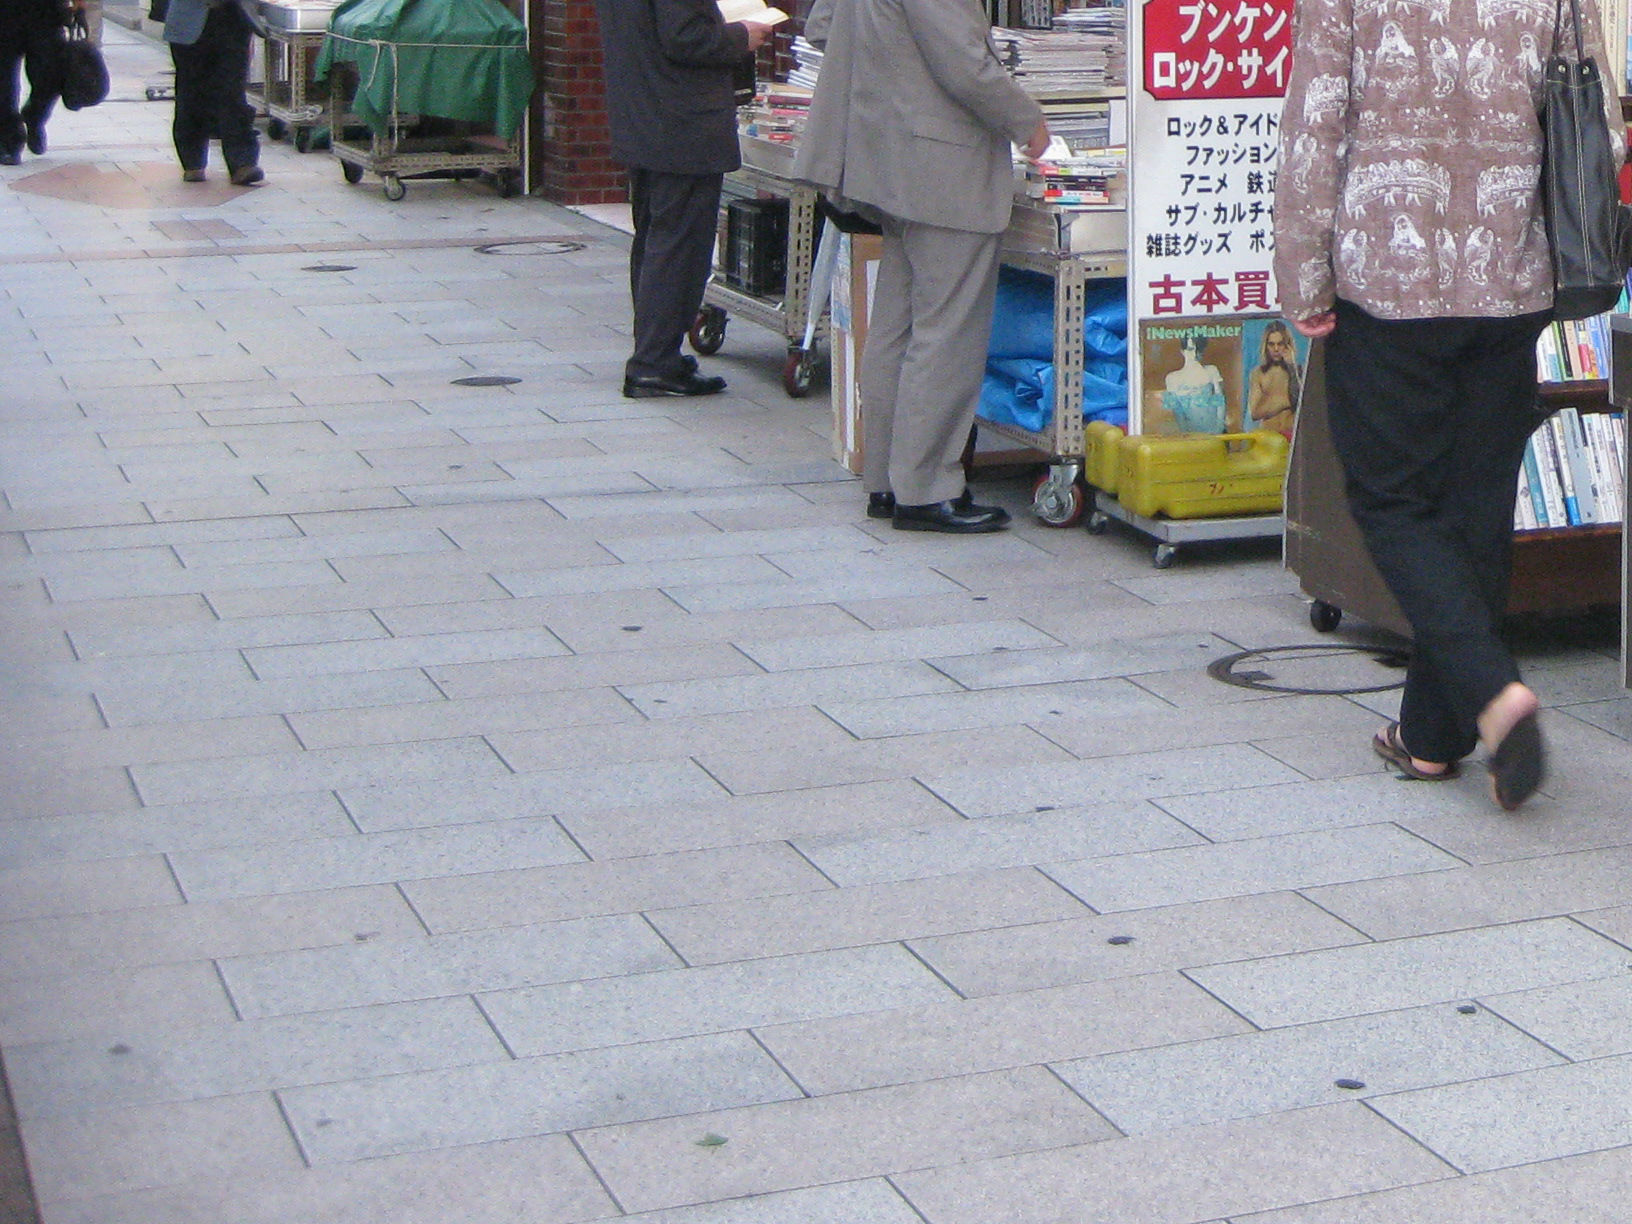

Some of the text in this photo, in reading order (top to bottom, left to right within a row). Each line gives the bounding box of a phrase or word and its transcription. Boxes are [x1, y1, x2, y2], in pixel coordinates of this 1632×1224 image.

[1186, 144, 1278, 166] ファッション
[1180, 173, 1229, 196] アニメ
[1146, 232, 1232, 258] 雑誌グッズ
[1148, 270, 1281, 316] 古本買
[1150, 325, 1243, 341] NewsMaker
